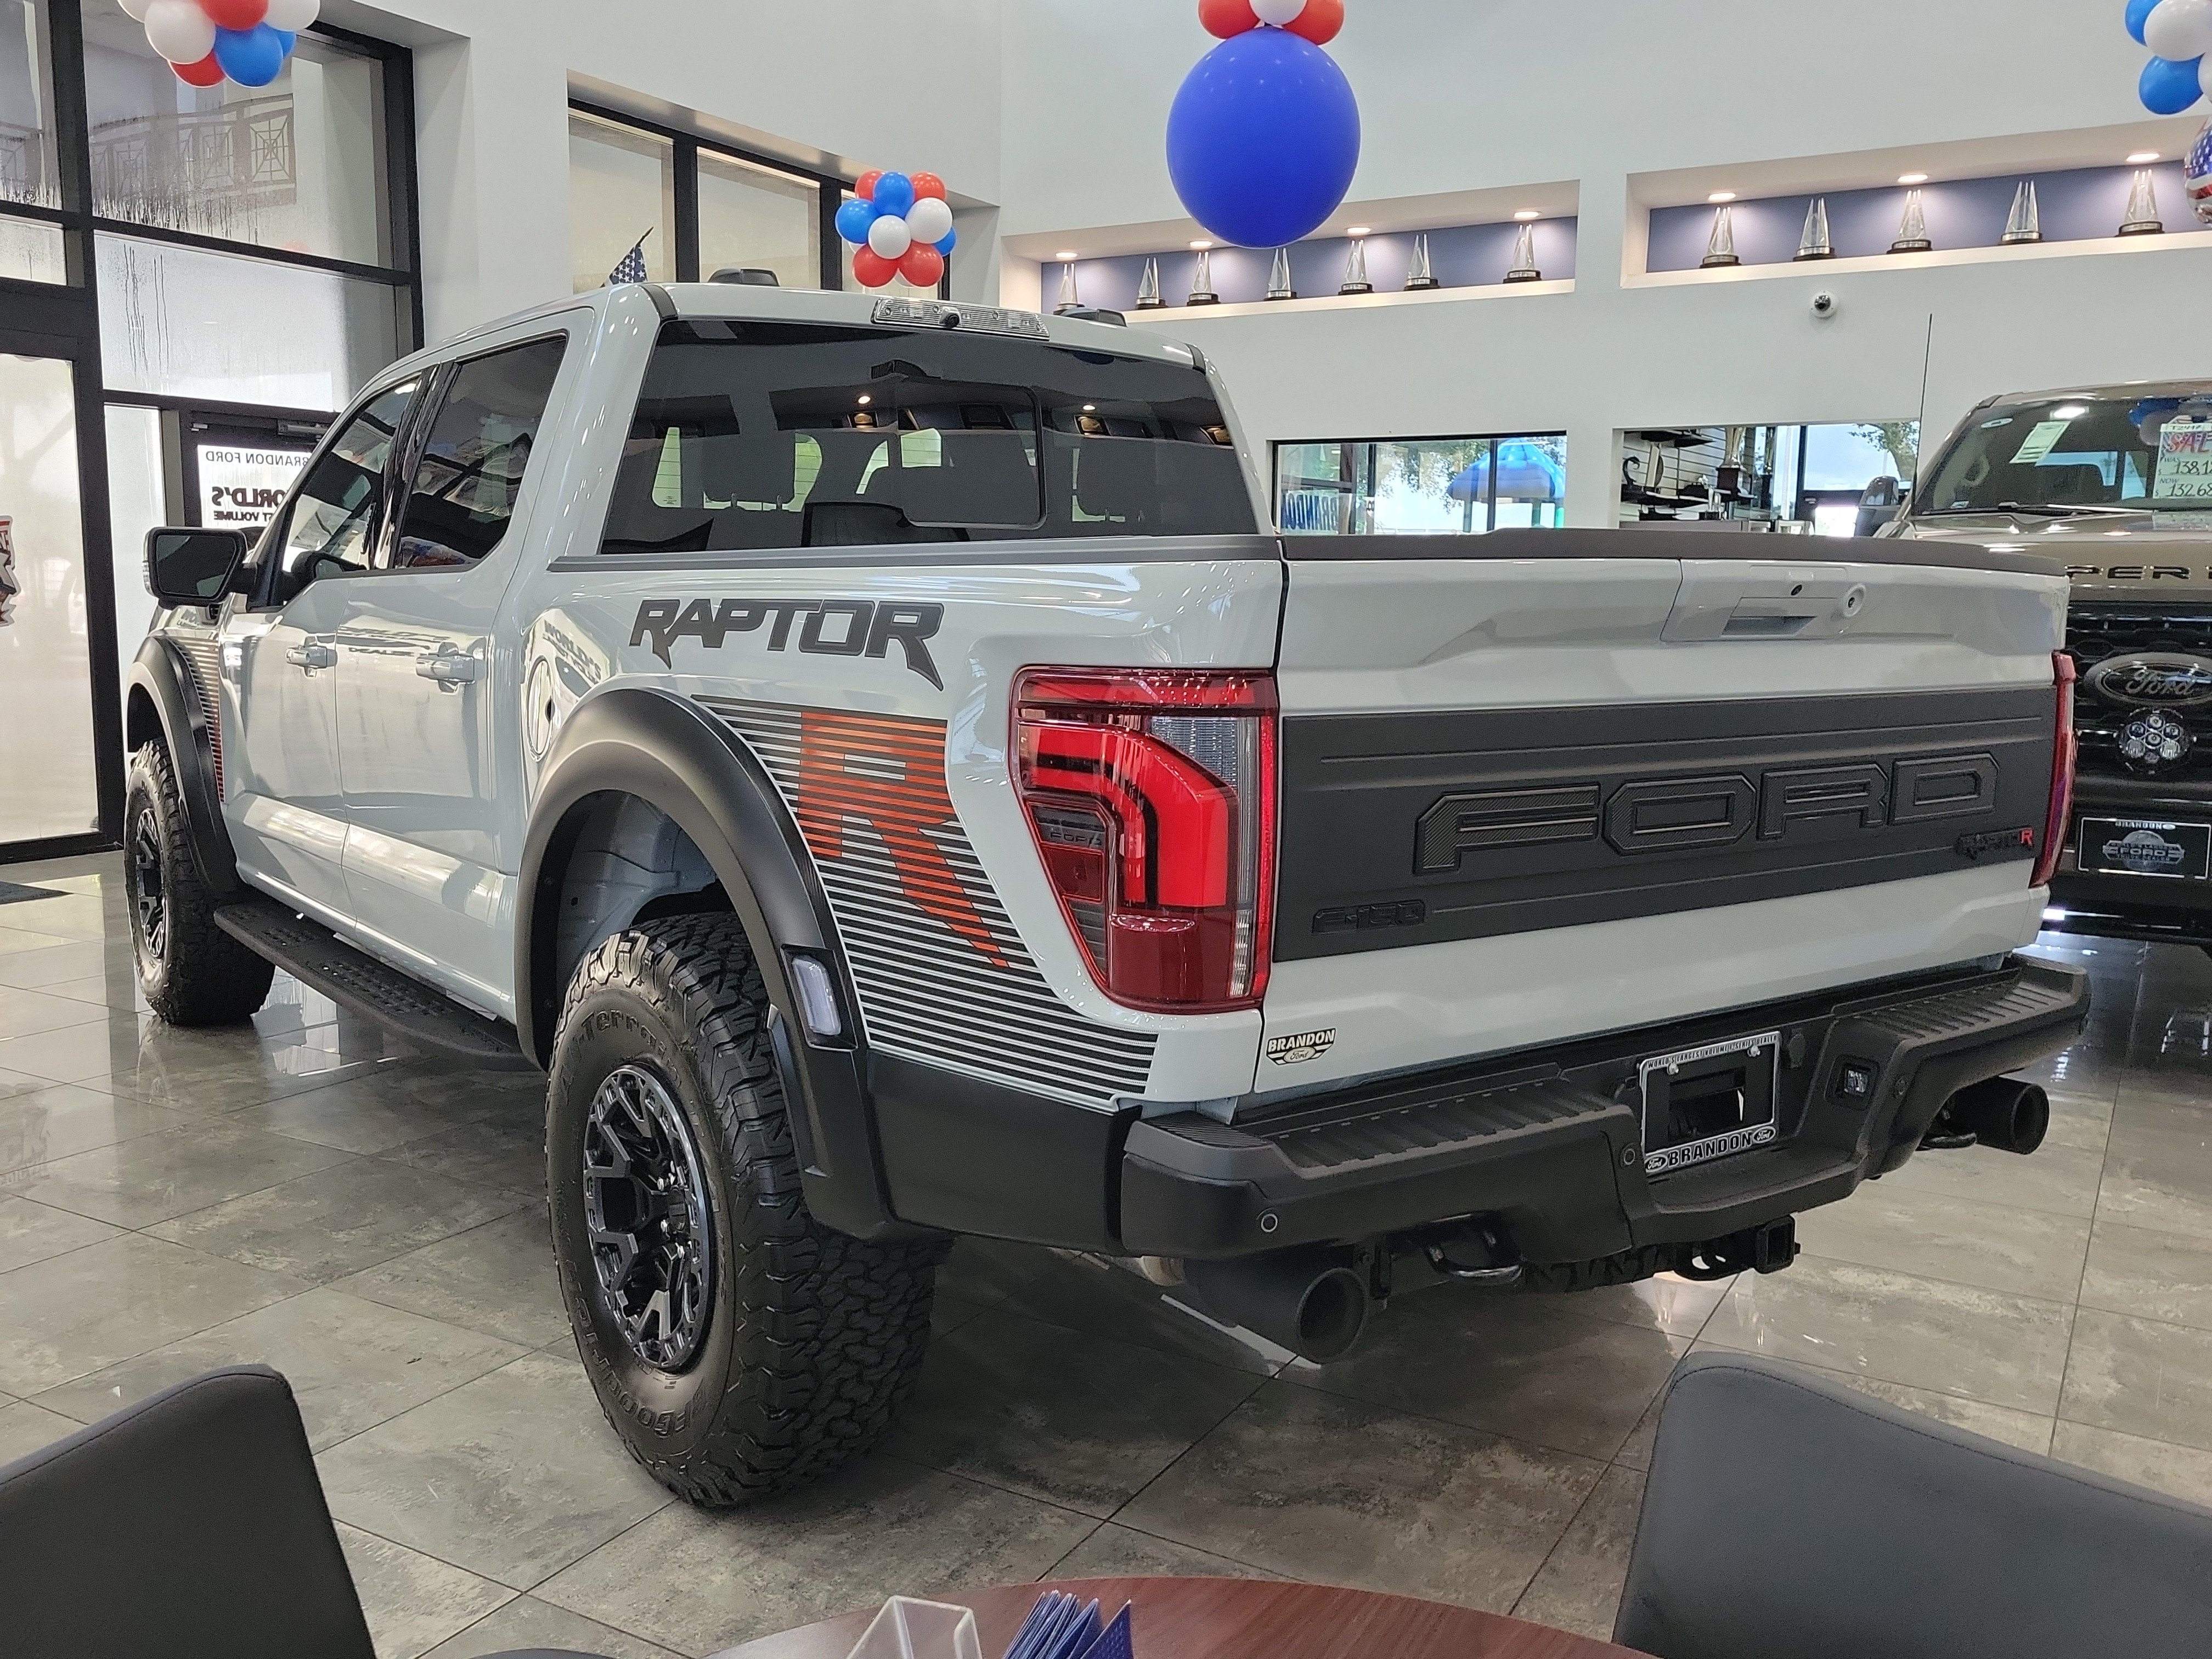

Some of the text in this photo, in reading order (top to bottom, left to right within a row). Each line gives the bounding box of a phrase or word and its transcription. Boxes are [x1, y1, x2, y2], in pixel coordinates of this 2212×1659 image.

[2166, 432, 2212, 453] SAL
[2065, 565, 2190, 579] PER
[629, 599, 944, 691] RAPTOR
[2125, 669, 2196, 695] Ford
[1413, 752, 2000, 874] FORD
[1312, 900, 1425, 933] F-150
[1268, 1029, 1335, 1053] BRANDON
[1290, 1049, 1309, 1060] Ford
[1648, 1057, 1675, 1069] WORLD'S
[1676, 1050, 1703, 1063] LARGEST
[1704, 1044, 1728, 1057] VOLUME
[1756, 1034, 1778, 1045] DEALER
[1647, 1131, 1771, 1169] Ford BRANDON Ford
